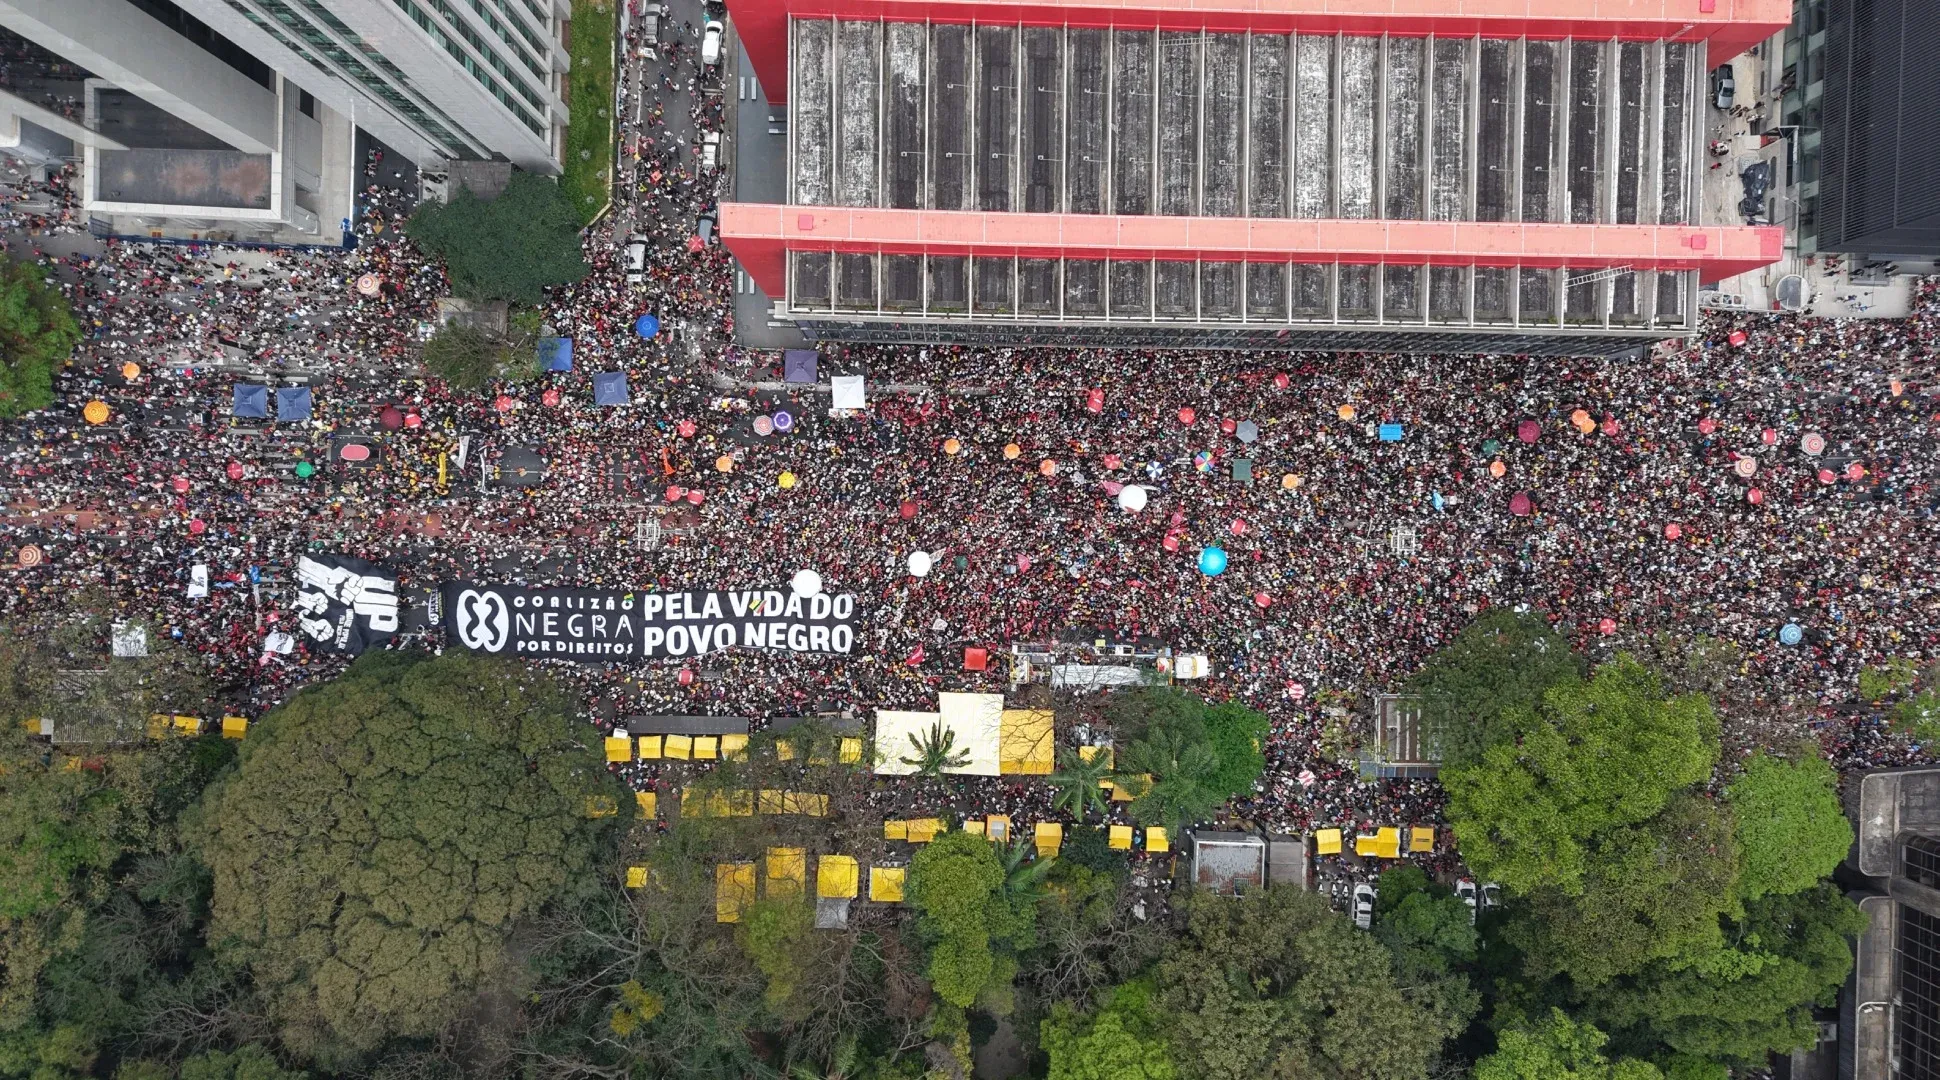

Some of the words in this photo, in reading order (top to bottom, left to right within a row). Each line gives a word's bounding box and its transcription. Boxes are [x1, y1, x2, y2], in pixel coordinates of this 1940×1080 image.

[353, 576, 398, 632] UP
[514, 596, 633, 610] COALIZÃO
[644, 592, 724, 621] PELA
[728, 591, 804, 619] VIDA
[809, 593, 854, 620] DO
[516, 612, 634, 638] NEGRA
[644, 623, 737, 656] POVO
[744, 622, 854, 653] NEGRO
[517, 641, 550, 652] POR
[556, 641, 634, 654] DIREITOS
